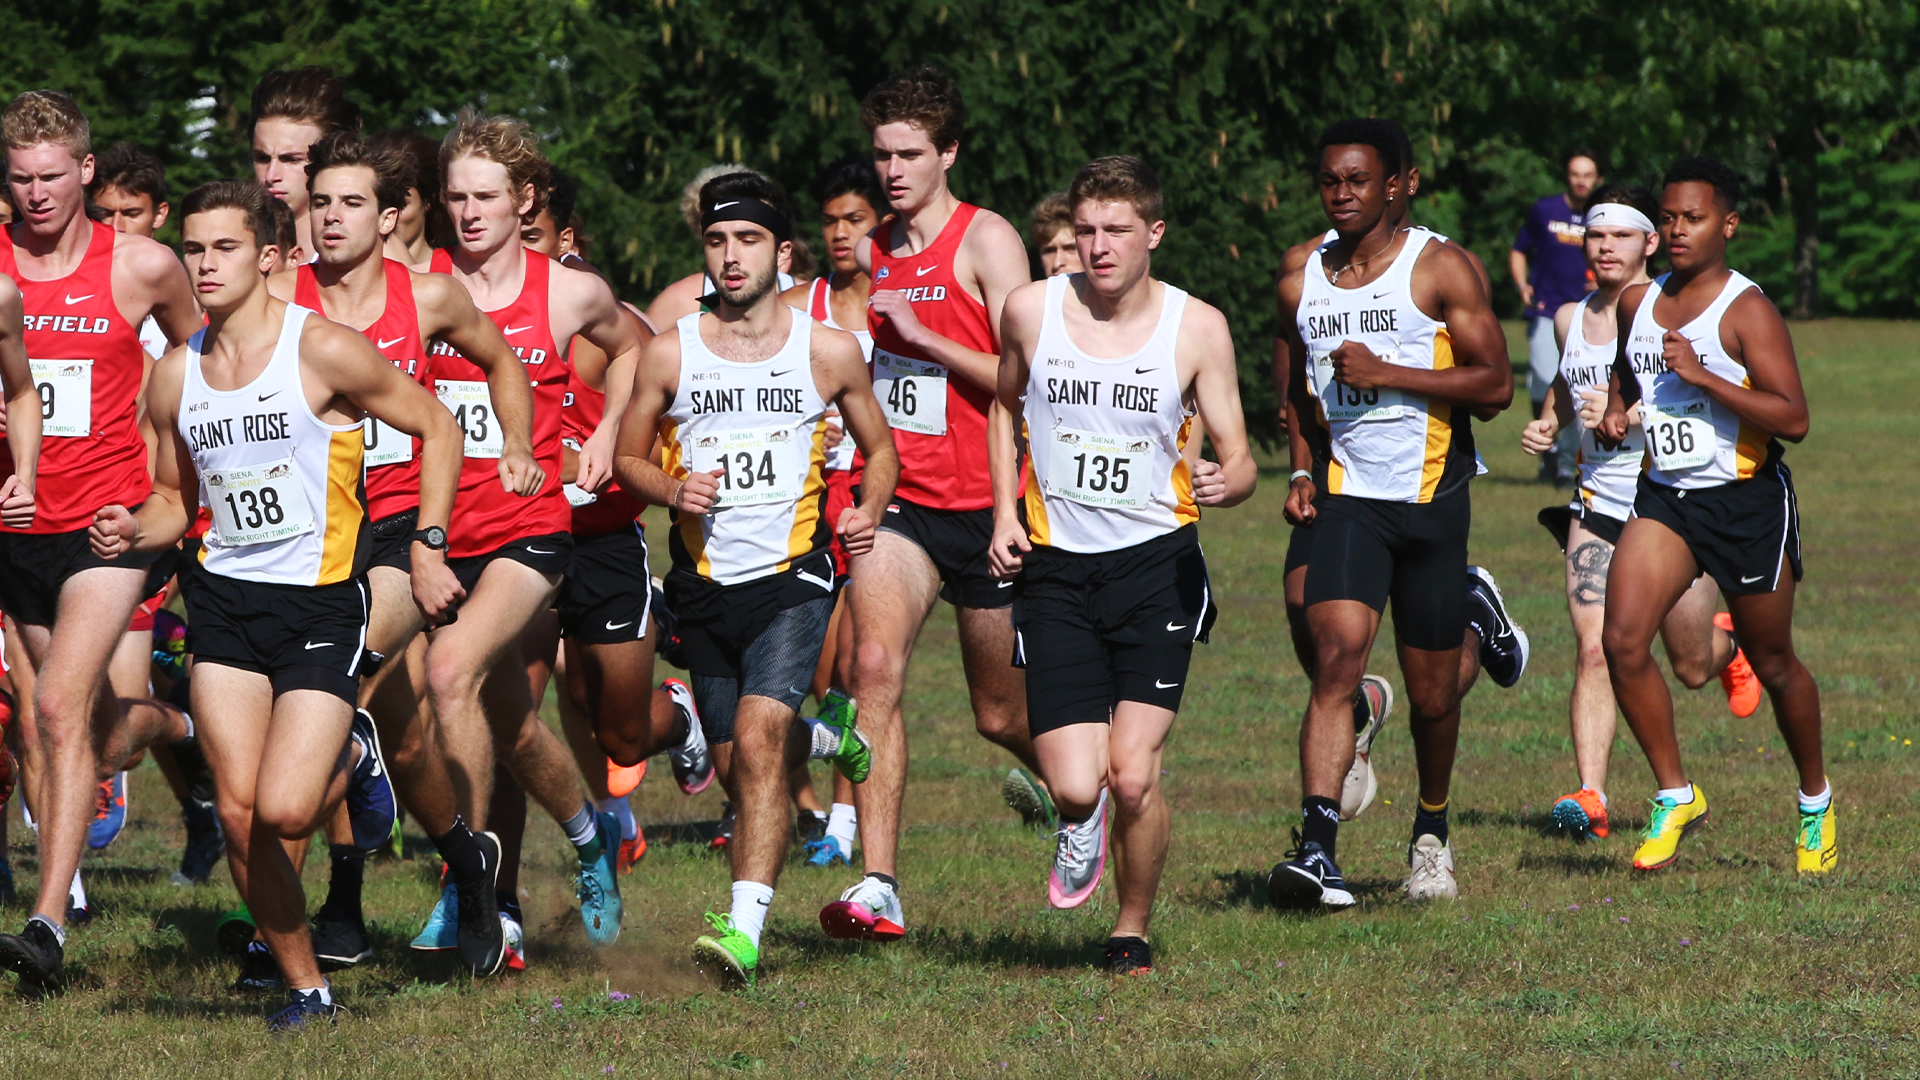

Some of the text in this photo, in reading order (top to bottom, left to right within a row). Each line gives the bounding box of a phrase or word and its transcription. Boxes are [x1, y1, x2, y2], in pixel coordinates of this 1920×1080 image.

[23, 315, 110, 334] RFIELD
[1308, 308, 1398, 340] SAINT ROSE
[30, 363, 47, 371] ENA
[1634, 352, 1670, 374] SAIN
[1566, 365, 1597, 387] SAINT
[458, 385, 482, 393] SIENA
[887, 377, 917, 416] 46
[1048, 378, 1159, 413] SAINT ROSE
[36, 382, 55, 420] 9
[691, 388, 803, 415] SAINT ROSE
[49, 425, 76, 433] TIMING
[455, 404, 488, 442] 43
[891, 417, 909, 427] RIGHT
[911, 420, 934, 431] TIMING
[189, 412, 291, 453] SAINT ROSE
[730, 432, 754, 440] SIENA
[1091, 435, 1116, 445] SIENA
[1646, 420, 1695, 457] 136
[463, 446, 502, 455] GHT TIMIN
[737, 440, 762, 449] INVITE
[1095, 444, 1121, 455] INVITE
[373, 452, 399, 461] TIMING
[230, 471, 254, 480] SIENA
[717, 450, 776, 490] 134
[1074, 453, 1130, 494] 135
[226, 478, 262, 489] XC INVITE
[734, 493, 758, 502] RIGHT
[760, 491, 787, 500] TIMING
[1058, 488, 1136, 506] FINISH RIGHT TIMING
[225, 486, 284, 531] 138
[247, 531, 269, 541] RIGHT
[272, 524, 300, 537] TIMING
